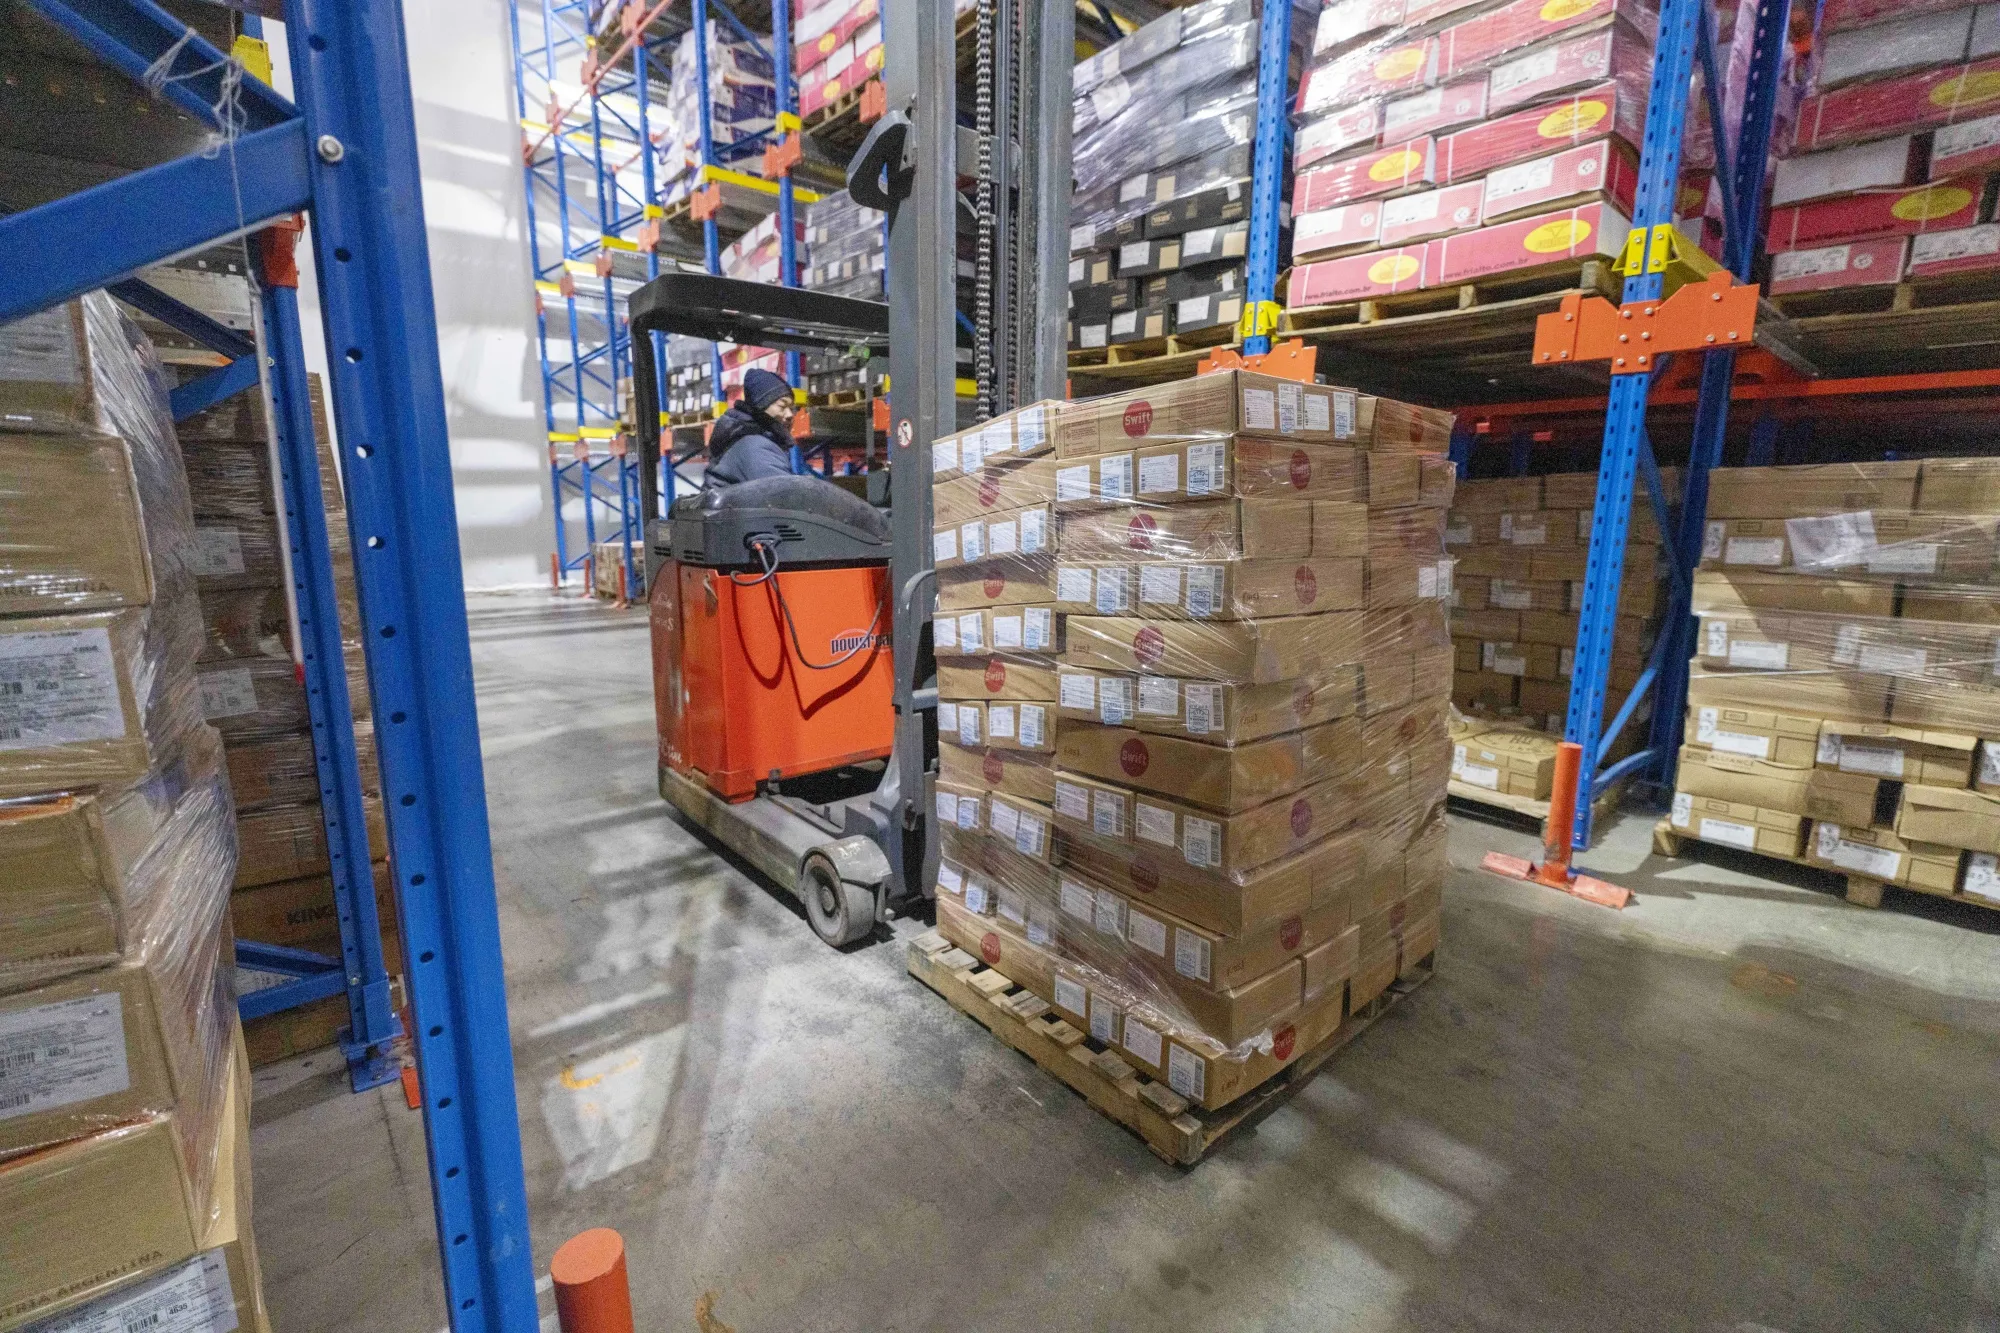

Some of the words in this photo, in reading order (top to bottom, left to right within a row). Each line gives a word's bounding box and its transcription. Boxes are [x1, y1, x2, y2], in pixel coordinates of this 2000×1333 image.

[1125, 412, 1151, 426] Swift
[985, 671, 1005, 681] Swift
[1122, 749, 1147, 765] Swift
[57, 1250, 163, 1298] ARGENTINA
[168, 1302, 189, 1316] 4635
